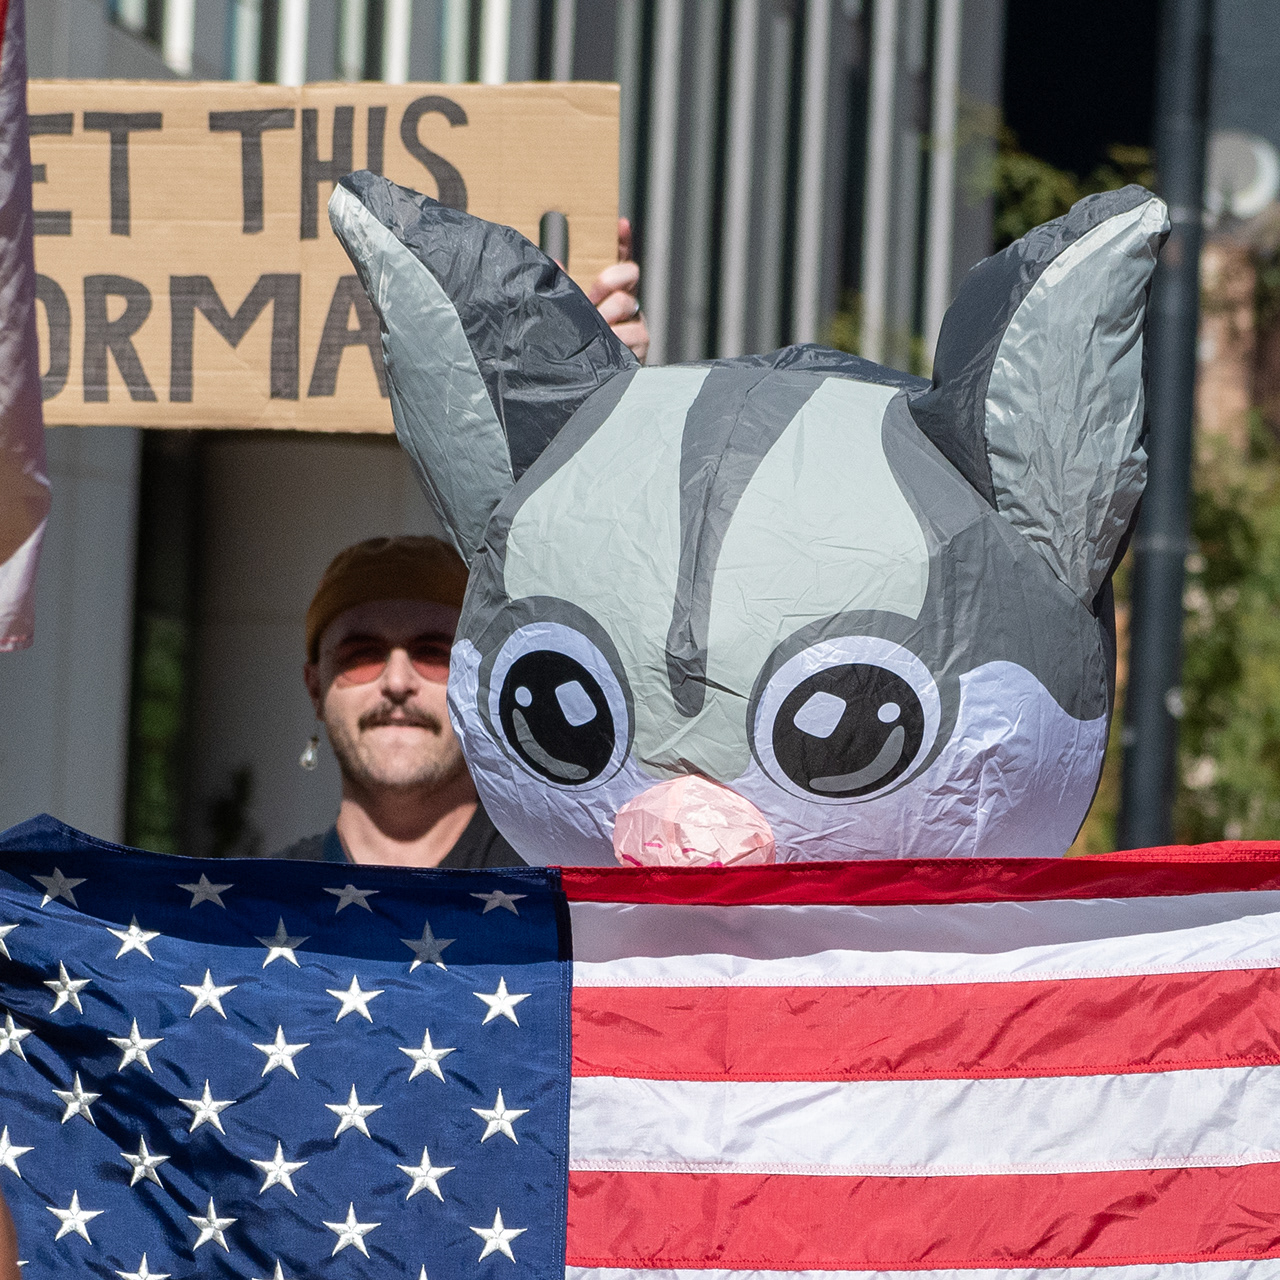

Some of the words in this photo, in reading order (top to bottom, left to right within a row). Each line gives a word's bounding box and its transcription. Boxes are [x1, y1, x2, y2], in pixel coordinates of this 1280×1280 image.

[27, 111, 163, 236] ET
[209, 95, 470, 240] THIS
[34, 272, 388, 404] ORMA
